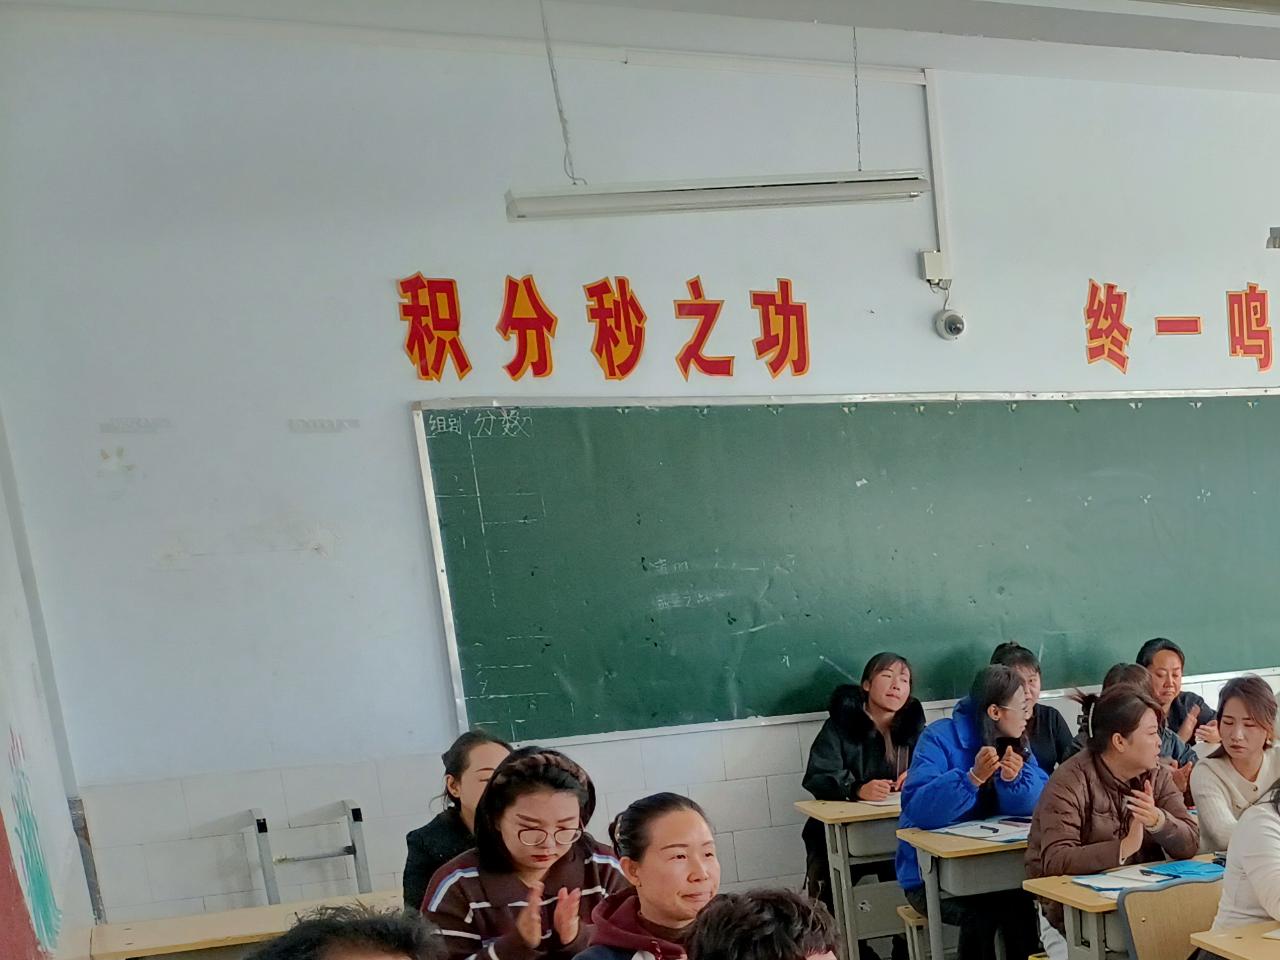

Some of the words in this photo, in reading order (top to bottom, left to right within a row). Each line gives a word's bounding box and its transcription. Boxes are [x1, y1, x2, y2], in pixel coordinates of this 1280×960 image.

[397, 271, 809, 381] 积分秒之功
[474, 407, 531, 437] 分数
